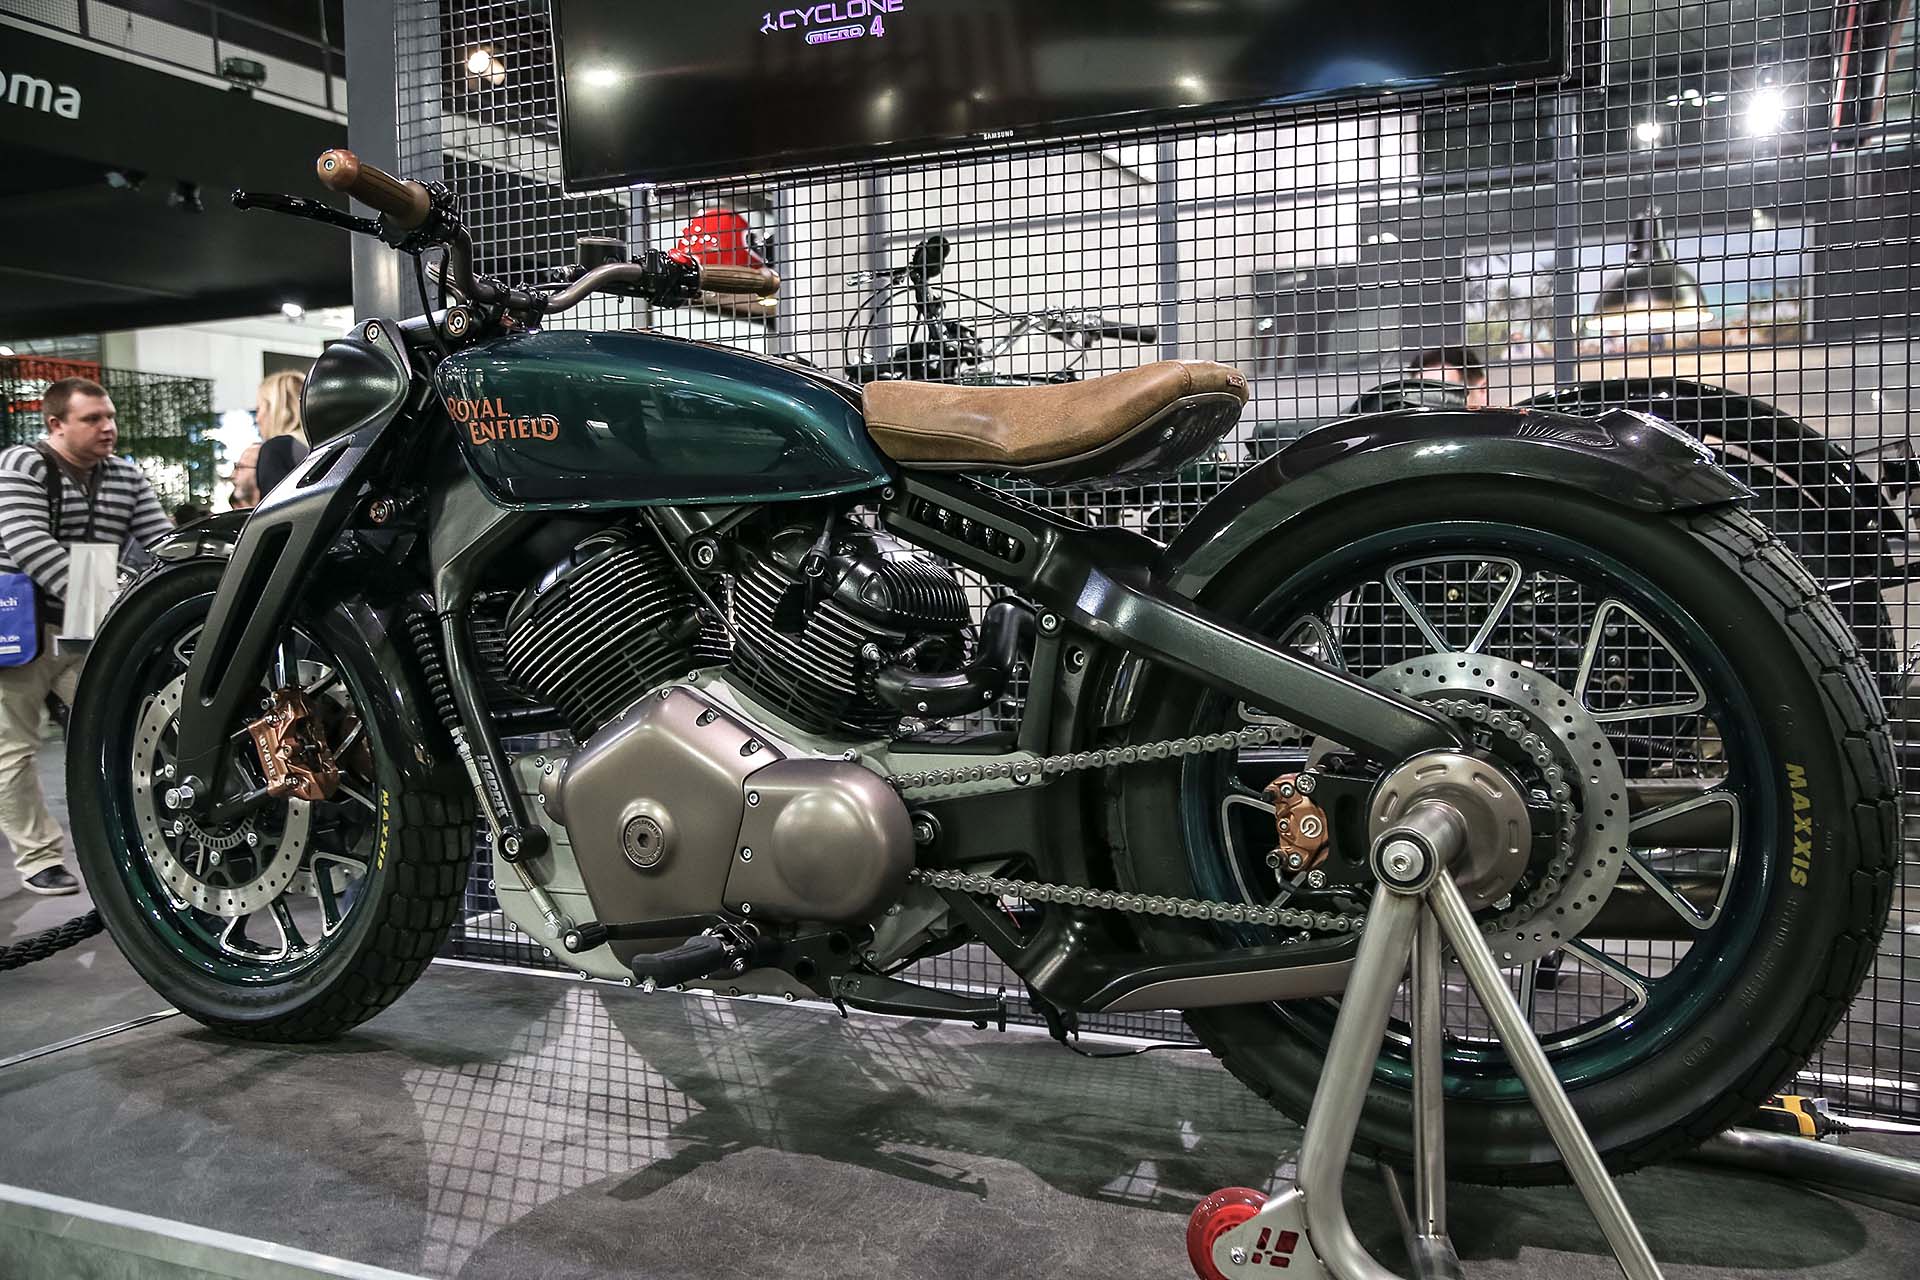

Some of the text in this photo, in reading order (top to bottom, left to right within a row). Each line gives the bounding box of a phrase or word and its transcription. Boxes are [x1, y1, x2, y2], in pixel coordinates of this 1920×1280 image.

[779, 0, 904, 29] CYCLONE
[808, 15, 885, 44] MICRO 4
[983, 130, 1014, 140] SAMSUNG
[447, 397, 508, 422] ROYAL
[468, 417, 560, 445] ENFIELD
[378, 789, 389, 870] MAXXIS
[1786, 763, 1812, 887] MAXXIS
